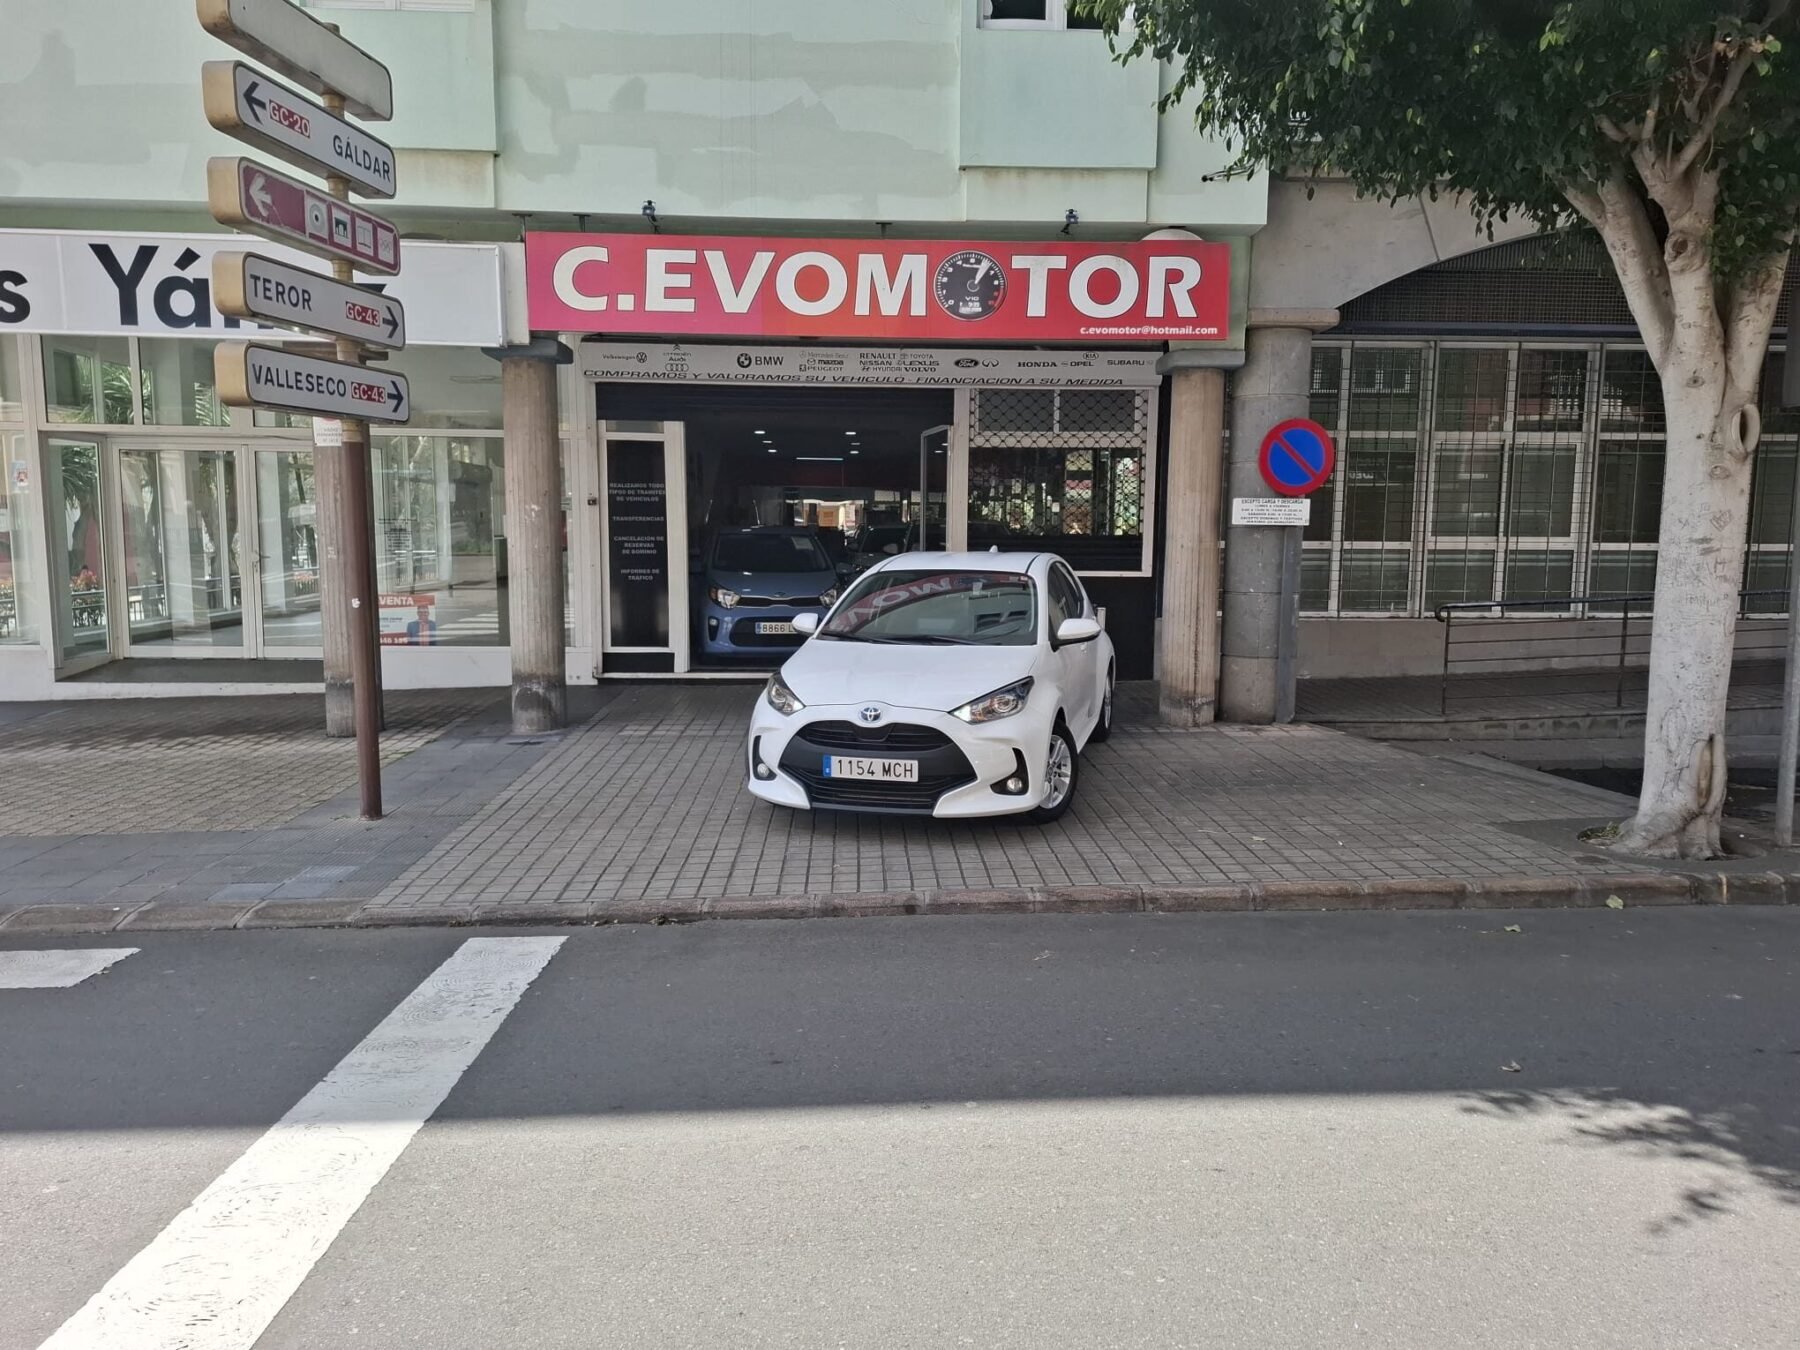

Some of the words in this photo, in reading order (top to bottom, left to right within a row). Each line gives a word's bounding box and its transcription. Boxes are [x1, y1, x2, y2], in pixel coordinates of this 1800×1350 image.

[270, 101, 310, 137] GC-20
[332, 134, 391, 182] GÁLDAR
[250, 273, 313, 311] TEROR
[346, 303, 380, 326] GC-43
[1080, 325, 1218, 335] c.evomotor@hotmail.com
[754, 355, 784, 366] BMW
[252, 363, 347, 397] VALLESECO
[584, 369, 688, 379] COMPRAMOS
[707, 372, 801, 381] VALORAMOS
[351, 382, 386, 403] GC-43
[378, 596, 415, 606] VENTA
[762, 624, 786, 632] 8866
[838, 759, 876, 777] 1154
[882, 762, 914, 778] MCH
